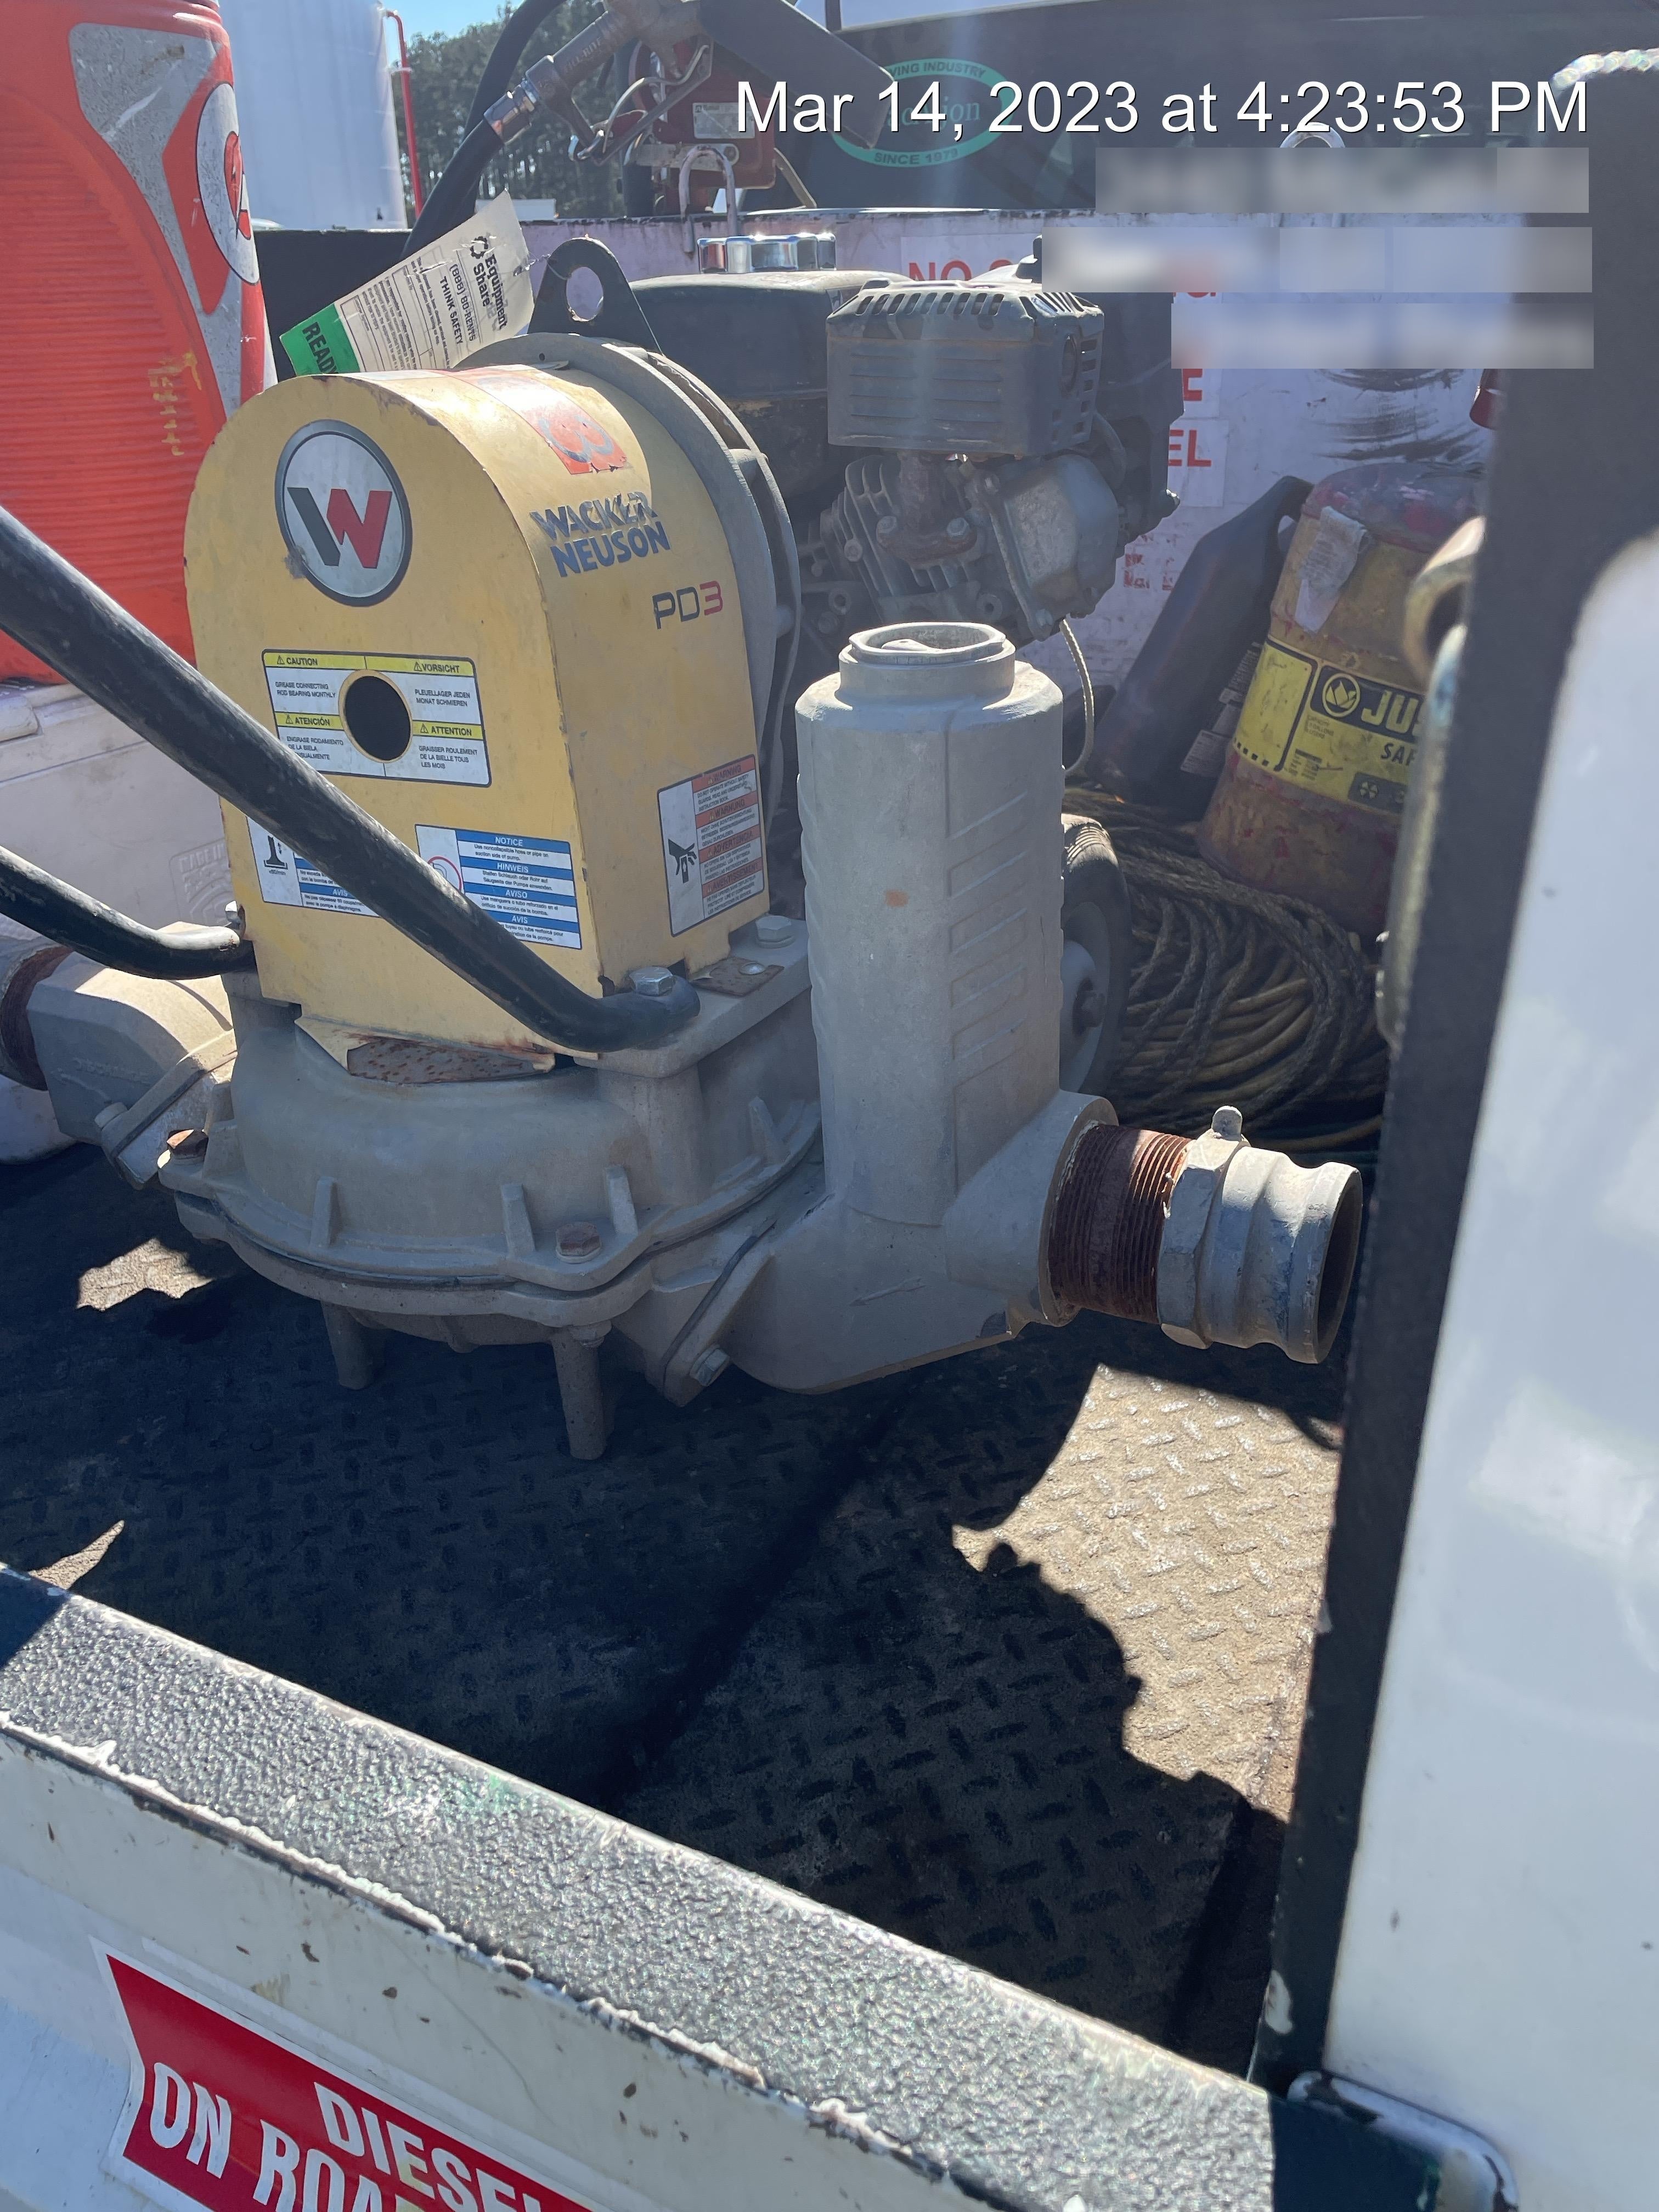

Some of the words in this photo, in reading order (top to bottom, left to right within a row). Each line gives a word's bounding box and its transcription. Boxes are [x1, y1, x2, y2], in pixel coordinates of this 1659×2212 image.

[923, 61, 986, 78] INDUSTRY
[874, 153, 920, 165] SINCE
[473, 262, 490, 307] Share
[486, 253, 508, 329] Equipment
[439, 276, 455, 313] THINK
[449, 307, 464, 346] SAFETY
[287, 487, 392, 569] W
[529, 491, 658, 540] WACKER
[550, 521, 670, 577] NEUSON
[652, 580, 723, 629] PD3
[286, 657, 318, 665] CAUTION
[422, 664, 460, 673] VORSICHT
[295, 716, 330, 726] ATENCIÓN
[431, 726, 472, 736] ATTENTION
[495, 836, 523, 847] NOTICE
[497, 862, 529, 873] HINWEIS
[505, 889, 528, 899] AVISO
[511, 915, 528, 924] AVIS
[150, 2062, 232, 2179] ON
[314, 2082, 542, 2212] DIESE
[253, 2119, 426, 2212] ROA
